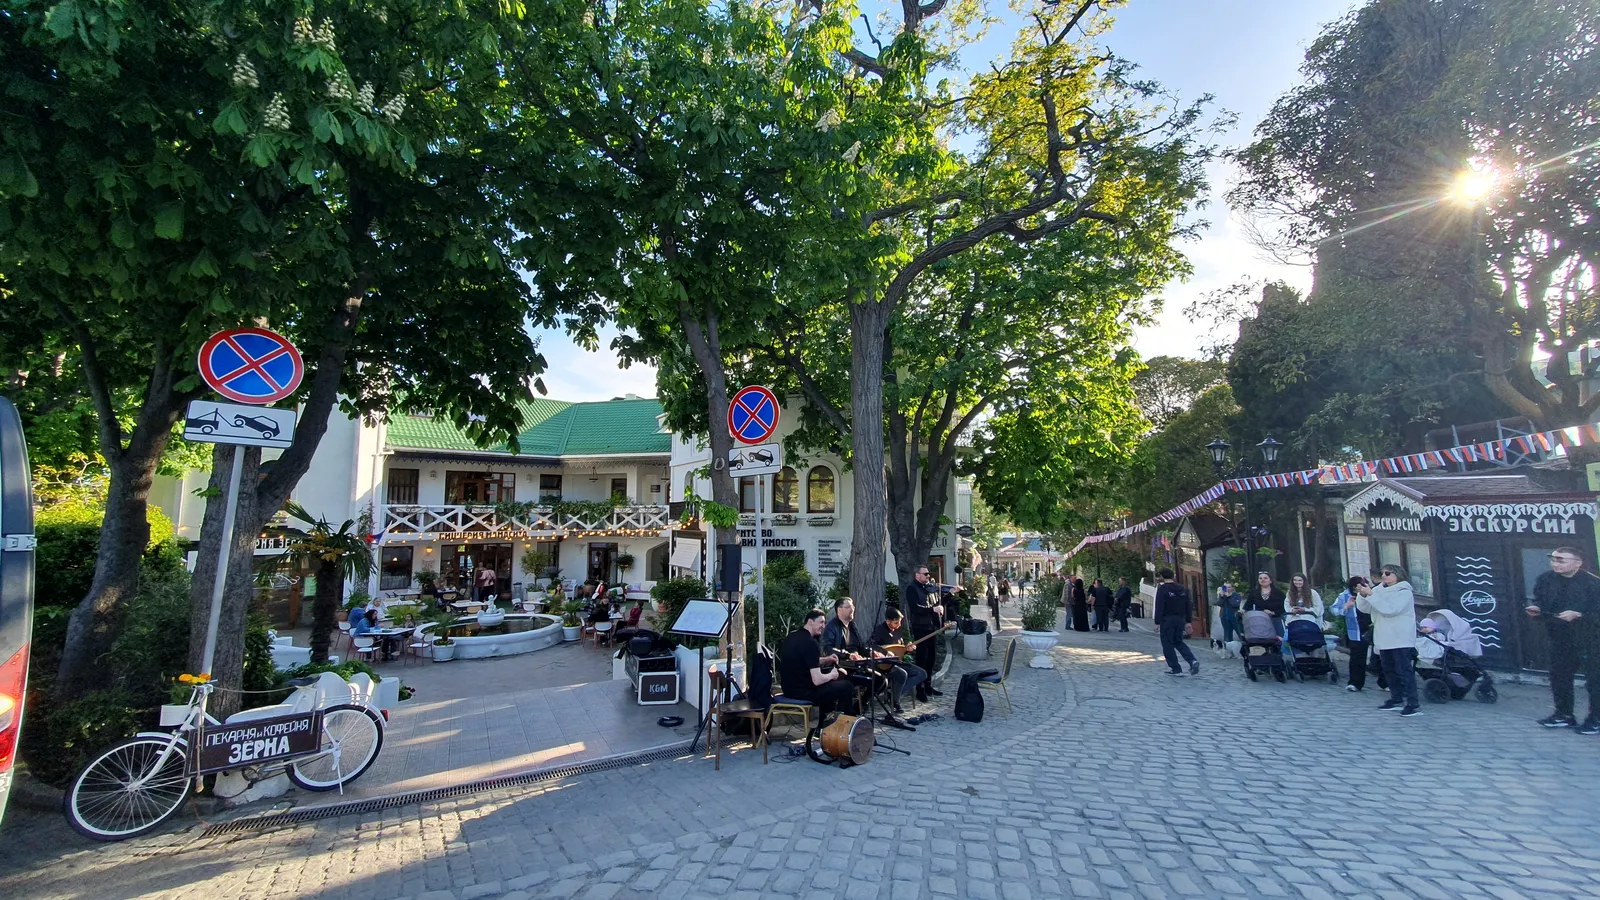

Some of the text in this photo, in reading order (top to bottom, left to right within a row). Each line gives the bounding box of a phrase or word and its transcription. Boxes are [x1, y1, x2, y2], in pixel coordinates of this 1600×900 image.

[1371, 517, 1421, 531] ЭКСКУРСИИ
[1449, 518, 1576, 534] ЭКСКУРСИИ
[206, 728, 256, 746] ПЕКАРНЯ
[263, 719, 309, 737] КОФЕЙНЯ
[228, 736, 290, 763] ЗЁРНА
